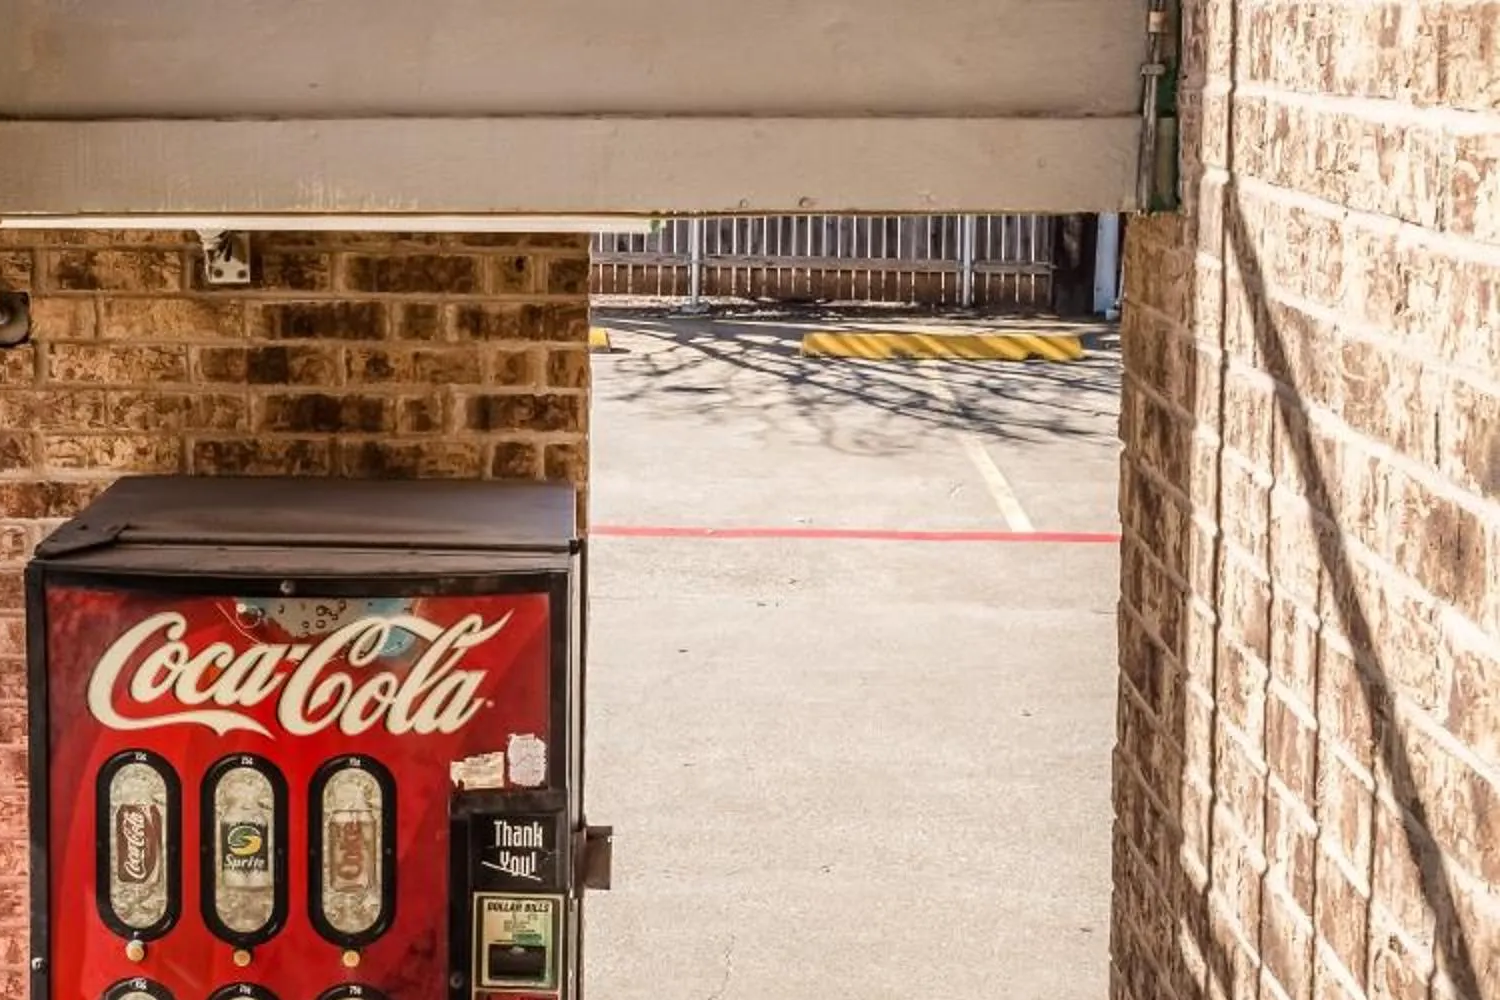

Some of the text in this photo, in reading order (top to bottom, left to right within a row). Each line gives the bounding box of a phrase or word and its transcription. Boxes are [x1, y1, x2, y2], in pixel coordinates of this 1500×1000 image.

[88, 610, 514, 739] Coca-Cola
[123, 809, 146, 879] Coca-Cola
[494, 819, 543, 848] Thank
[224, 854, 265, 872] Sprite
[499, 851, 536, 877] You!
[487, 902, 522, 912] DOLLAR
